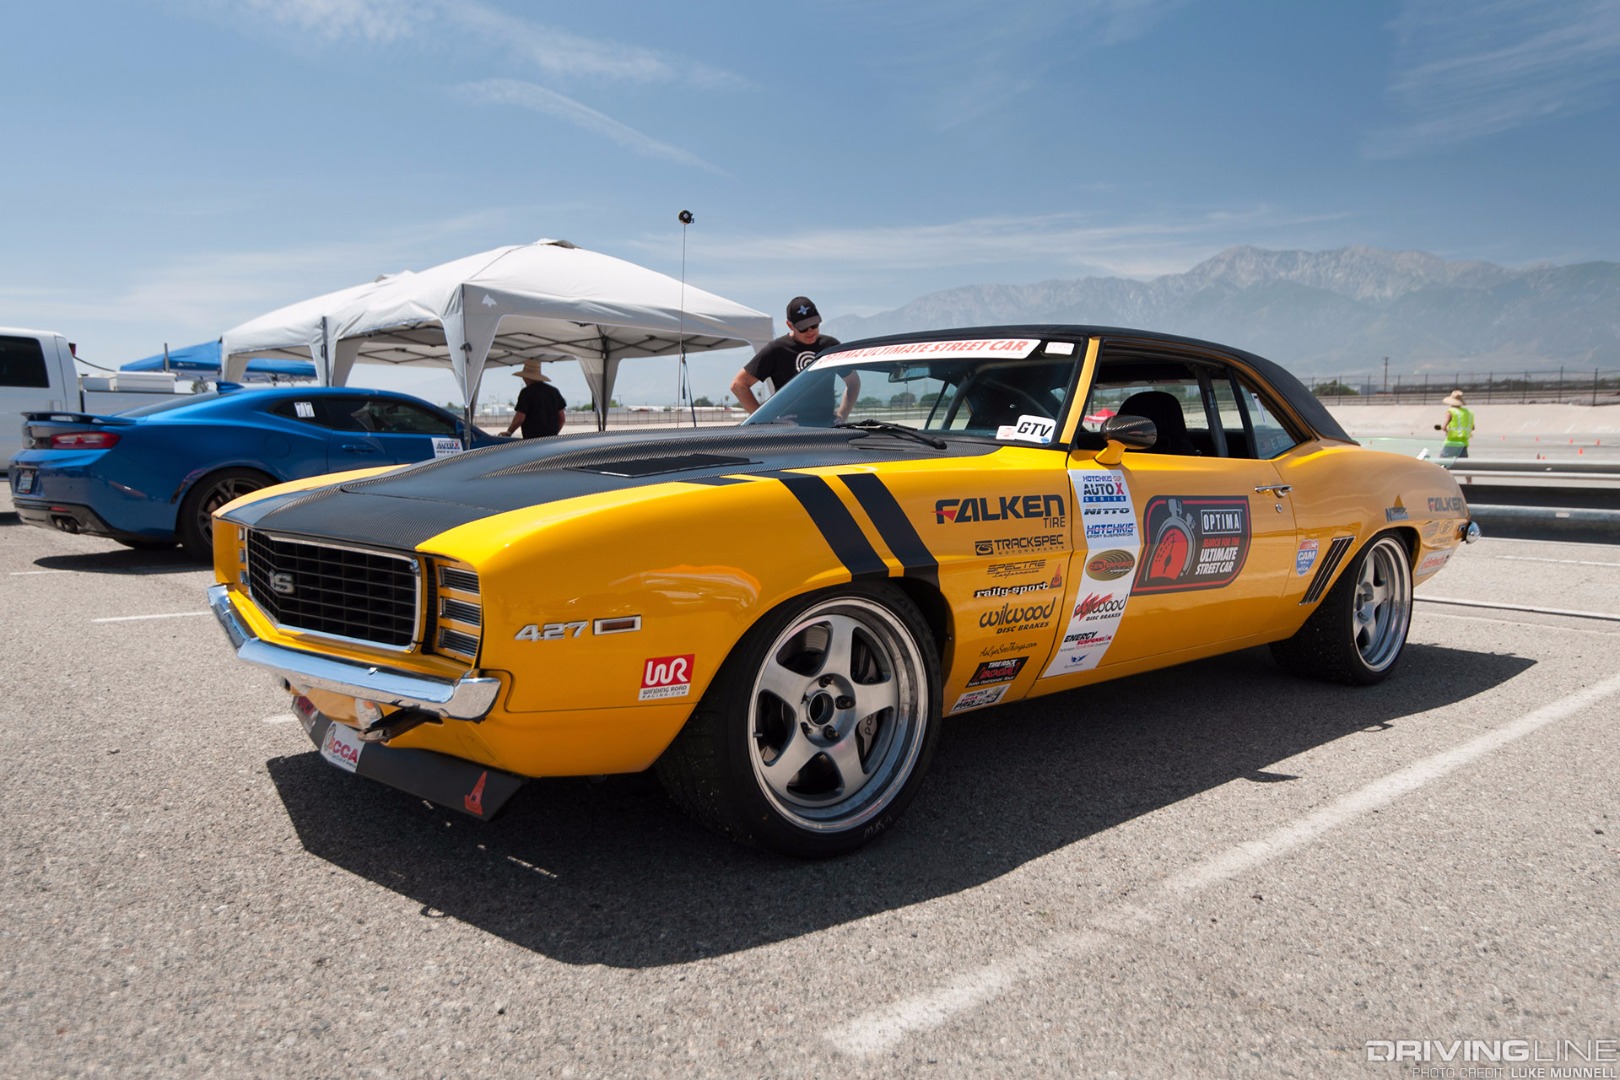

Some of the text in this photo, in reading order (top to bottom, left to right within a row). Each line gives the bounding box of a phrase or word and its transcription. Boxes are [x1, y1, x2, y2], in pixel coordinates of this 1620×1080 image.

[862, 344, 932, 358] ULTIMATE
[929, 341, 991, 353] STREET
[989, 341, 1028, 351] CAR
[1017, 421, 1053, 437] GTV
[1084, 482, 1125, 495] AUTO X
[934, 494, 1066, 525] FALKEN
[1043, 517, 1066, 528] TIRE
[1086, 523, 1134, 535] HOTCHKIS
[1203, 514, 1240, 531] OPTIMA
[994, 534, 1064, 550] TRACKSPEC
[1200, 547, 1239, 562] ULTIMATE
[1298, 551, 1315, 561] CAM
[987, 559, 1046, 574] SPECTRE
[1195, 562, 1234, 575] STREET CAR
[974, 581, 1049, 598] rally-sport
[979, 597, 1056, 628] wilwood
[1100, 612, 1121, 620] BRAKES
[514, 620, 589, 641] 427
[997, 621, 1049, 634] DISC BRAKES
[1063, 631, 1098, 643] ENERGY
[645, 657, 689, 686] WR
